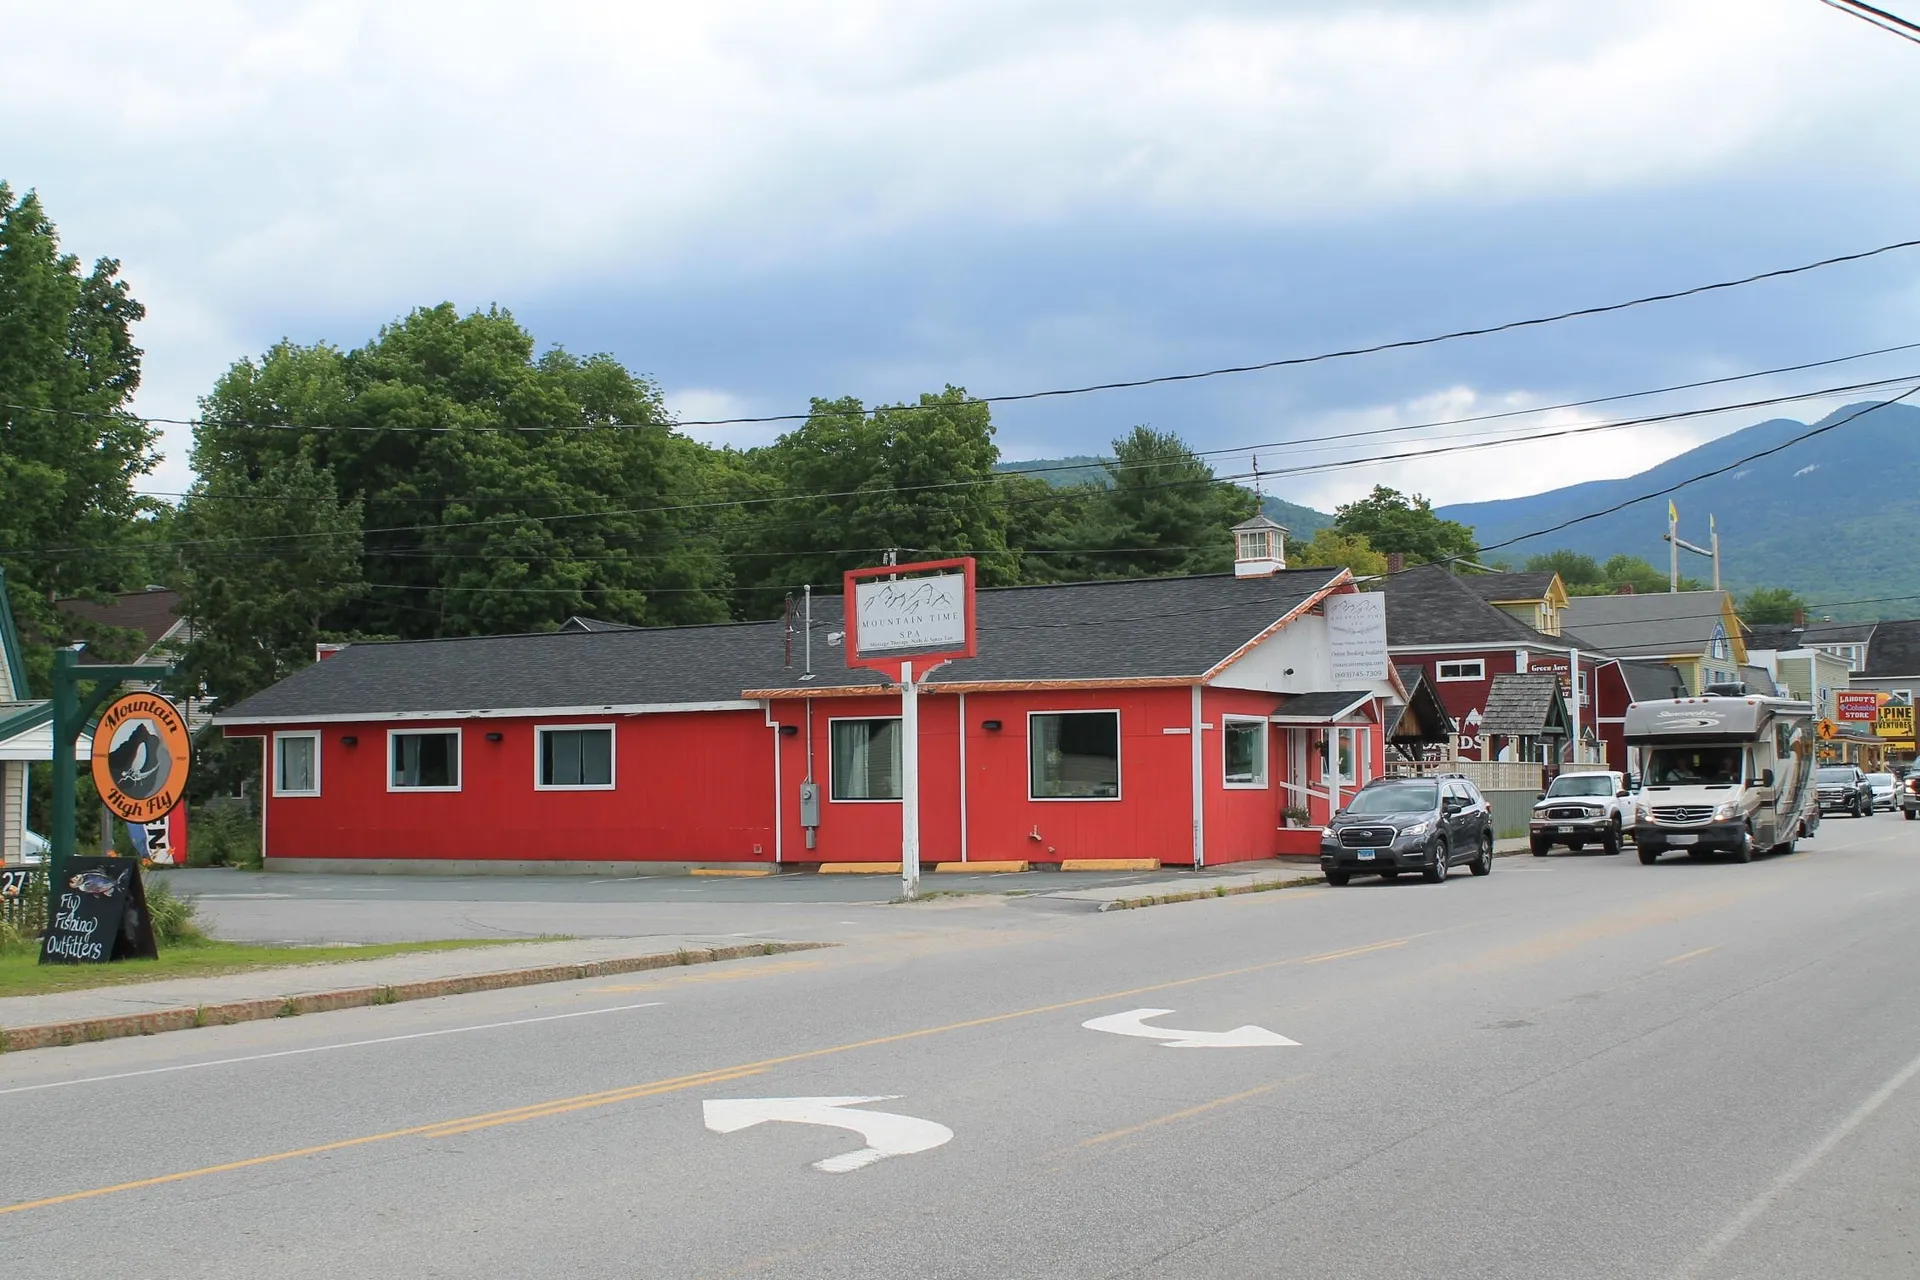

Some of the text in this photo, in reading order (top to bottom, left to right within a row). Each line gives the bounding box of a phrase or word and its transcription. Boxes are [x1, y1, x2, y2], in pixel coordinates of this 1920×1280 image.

[862, 612, 958, 628] MOUNTAIN TIME
[899, 630, 920, 639] SPA
[1531, 664, 1552, 672] Green
[1839, 696, 1875, 704] LAHOUT'S
[104, 700, 178, 734] Mountain
[1845, 711, 1870, 719] STORE
[107, 788, 173, 817] High Fly
[2, 871, 27, 896] 27
[60, 893, 81, 918] Fly
[54, 912, 98, 942] Fishing
[46, 935, 103, 959] Outfitters
